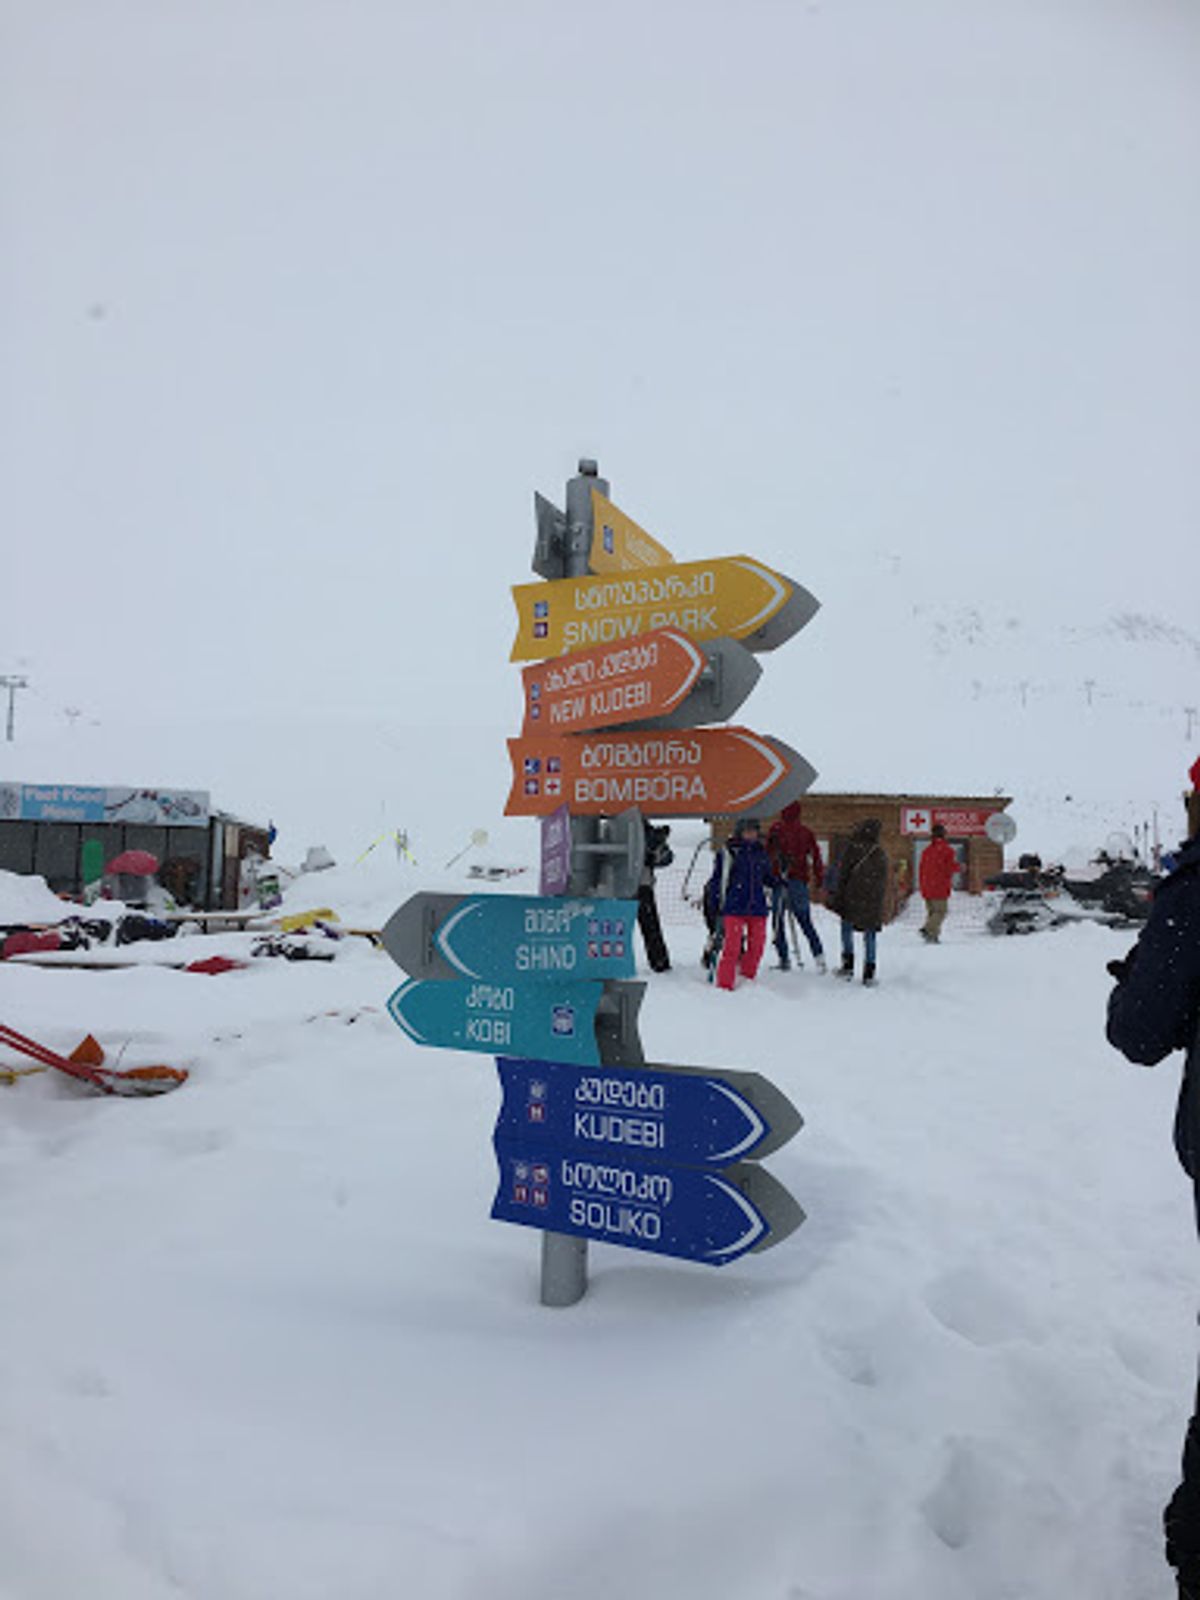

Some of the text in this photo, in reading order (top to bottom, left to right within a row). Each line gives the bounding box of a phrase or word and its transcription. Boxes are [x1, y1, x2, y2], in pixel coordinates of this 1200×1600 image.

[563, 606, 719, 646] SNOW PARK
[550, 681, 652, 724] NEW KUDEBI
[580, 740, 702, 768] ბომბორა
[574, 775, 707, 802] BOMBORA
[515, 943, 577, 971] SHINO
[466, 1018, 512, 1045] KOBI
[574, 1077, 664, 1110] კუდები
[574, 1112, 665, 1148] KUDEBI
[562, 1159, 672, 1205] სოლიკო
[569, 1200, 661, 1240] SOLIKO
